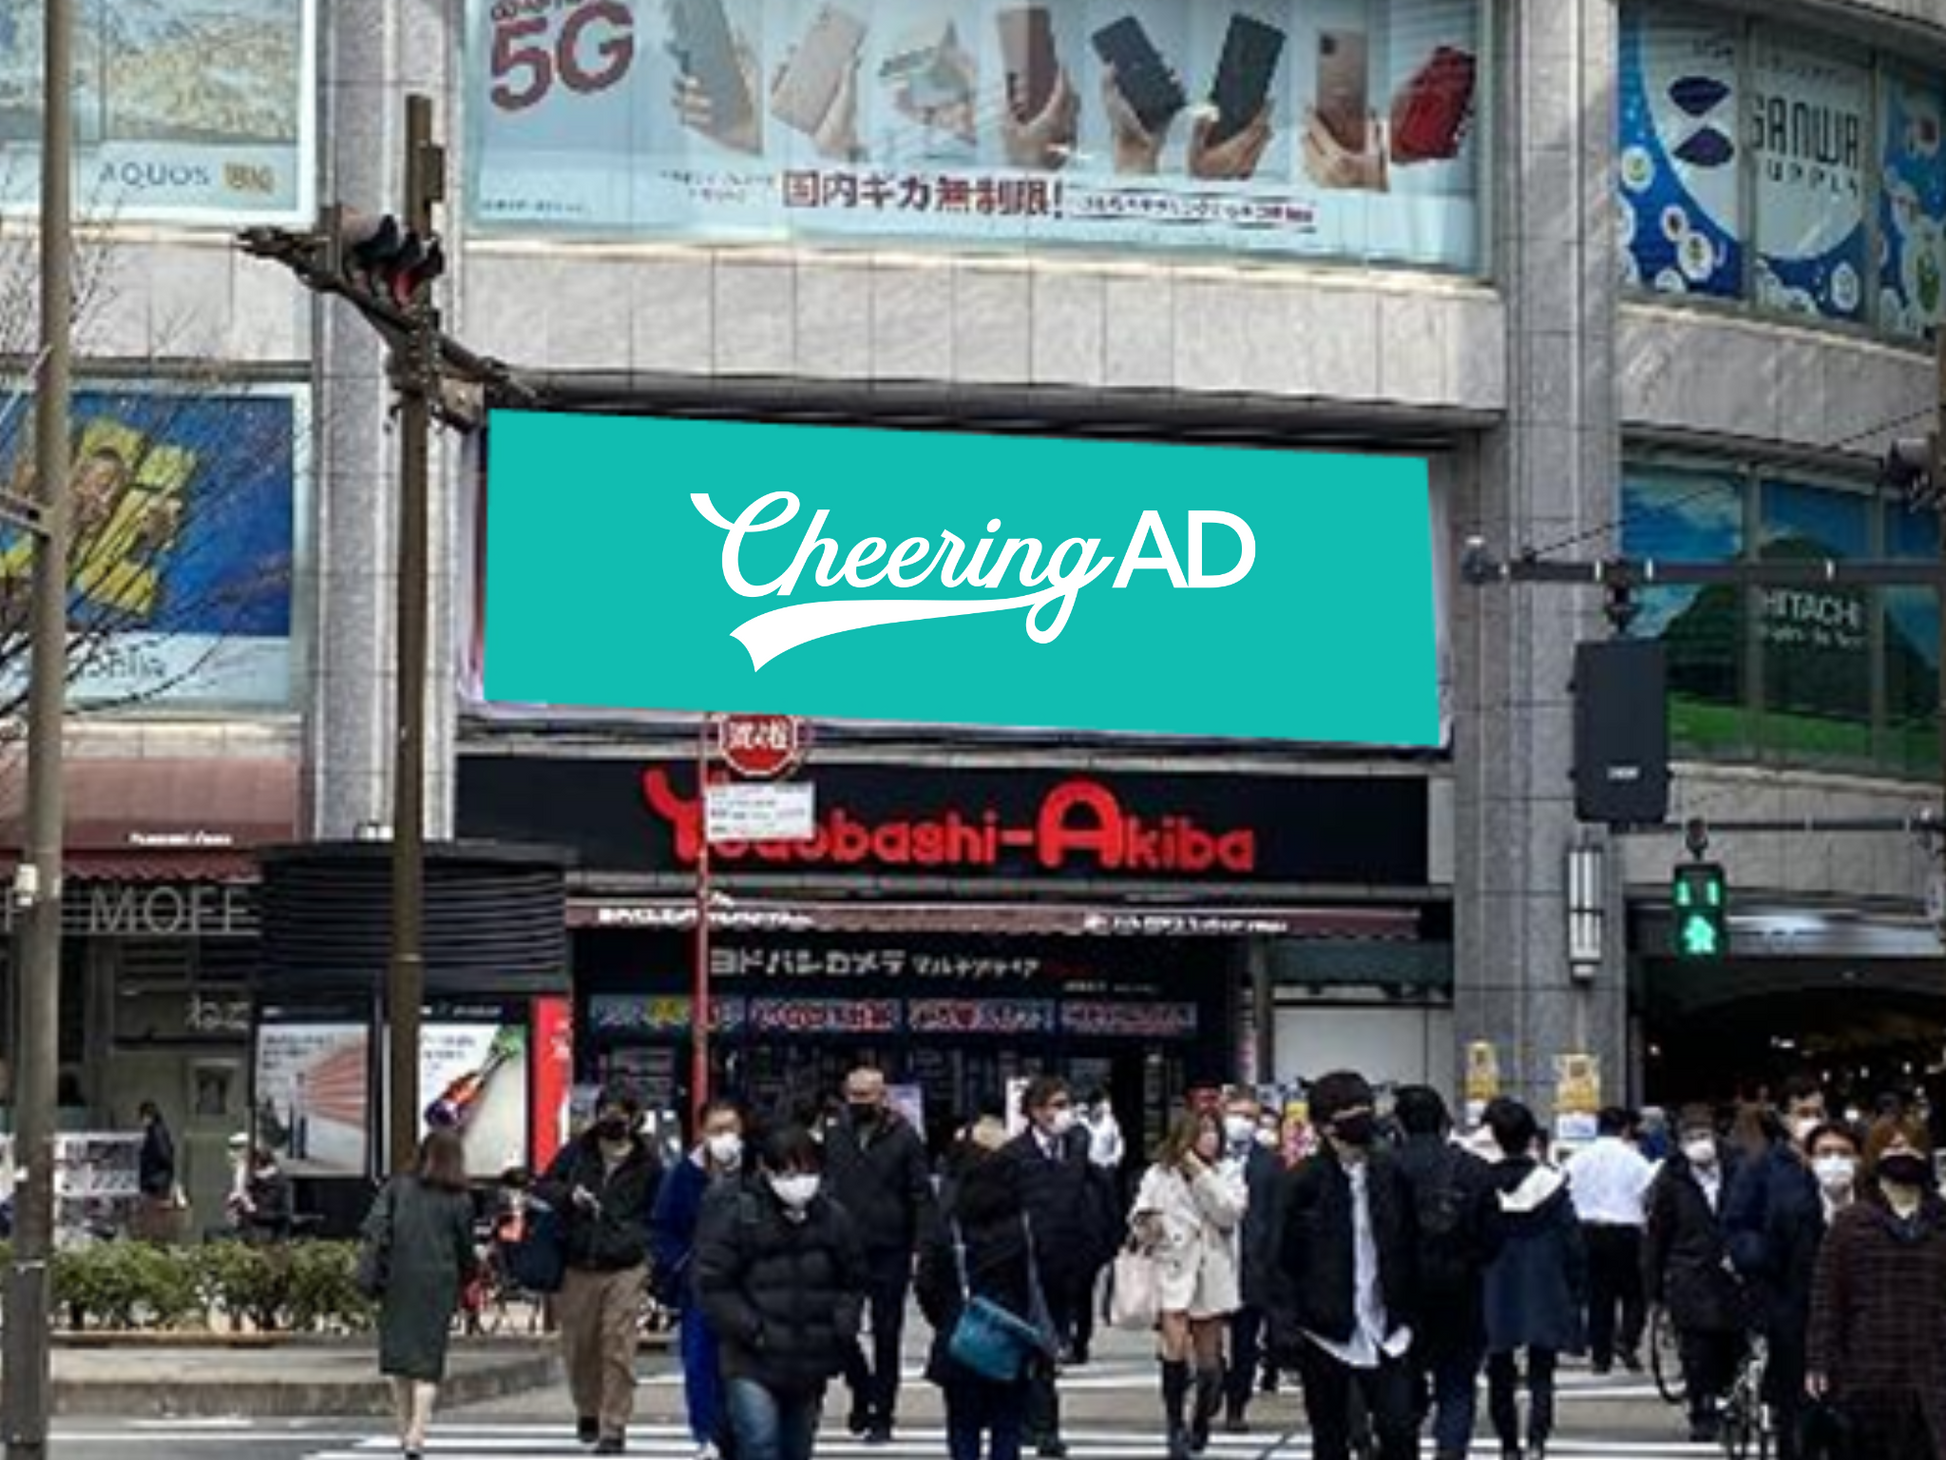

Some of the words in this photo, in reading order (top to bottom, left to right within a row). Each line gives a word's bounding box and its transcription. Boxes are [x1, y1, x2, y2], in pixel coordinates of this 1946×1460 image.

[490, 0, 634, 111] 5G
[98, 161, 211, 188] AQUOS
[643, 769, 1254, 870] Yobashi-Akiba
